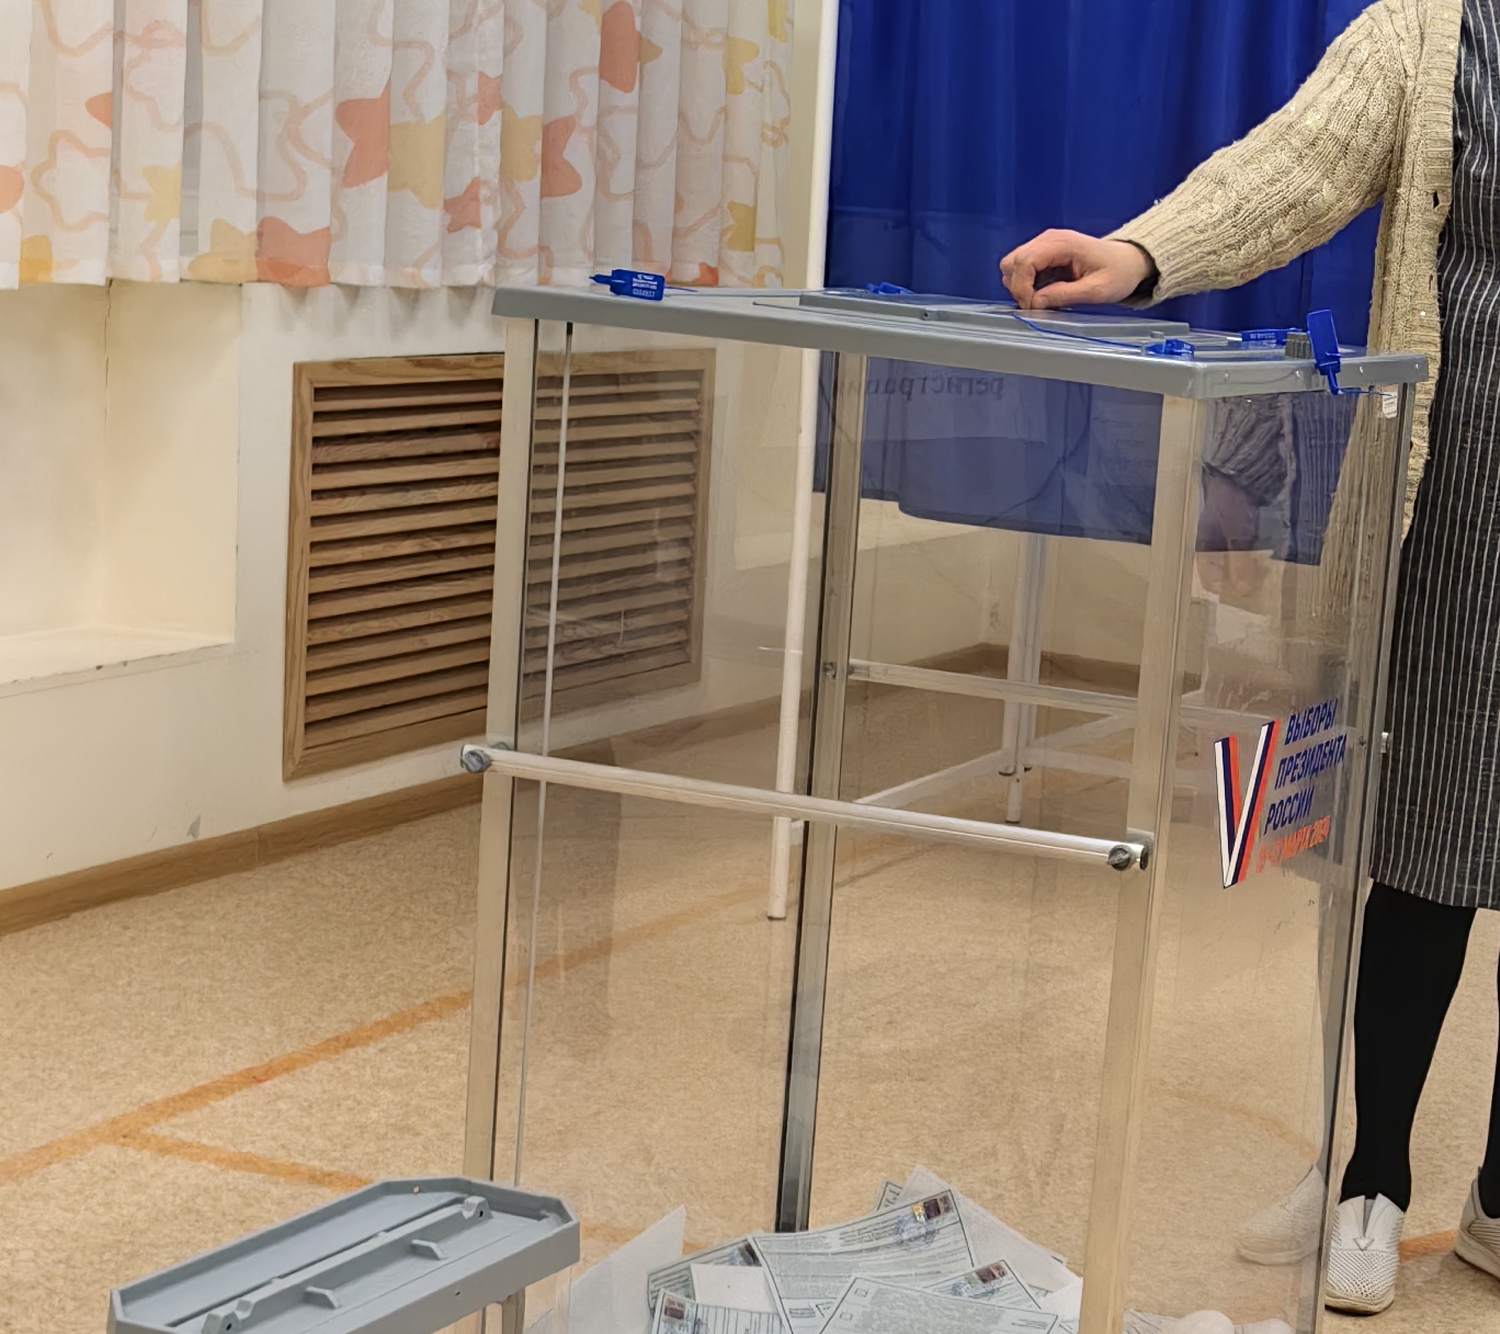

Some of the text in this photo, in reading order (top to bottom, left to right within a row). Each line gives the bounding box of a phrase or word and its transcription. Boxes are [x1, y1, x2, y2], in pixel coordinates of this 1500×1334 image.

[1284, 698, 1339, 746] ВЫБОРЫ
[1274, 734, 1348, 791] ПРЕЗИДЕНТА
[1263, 786, 1315, 836] РОССИИ
